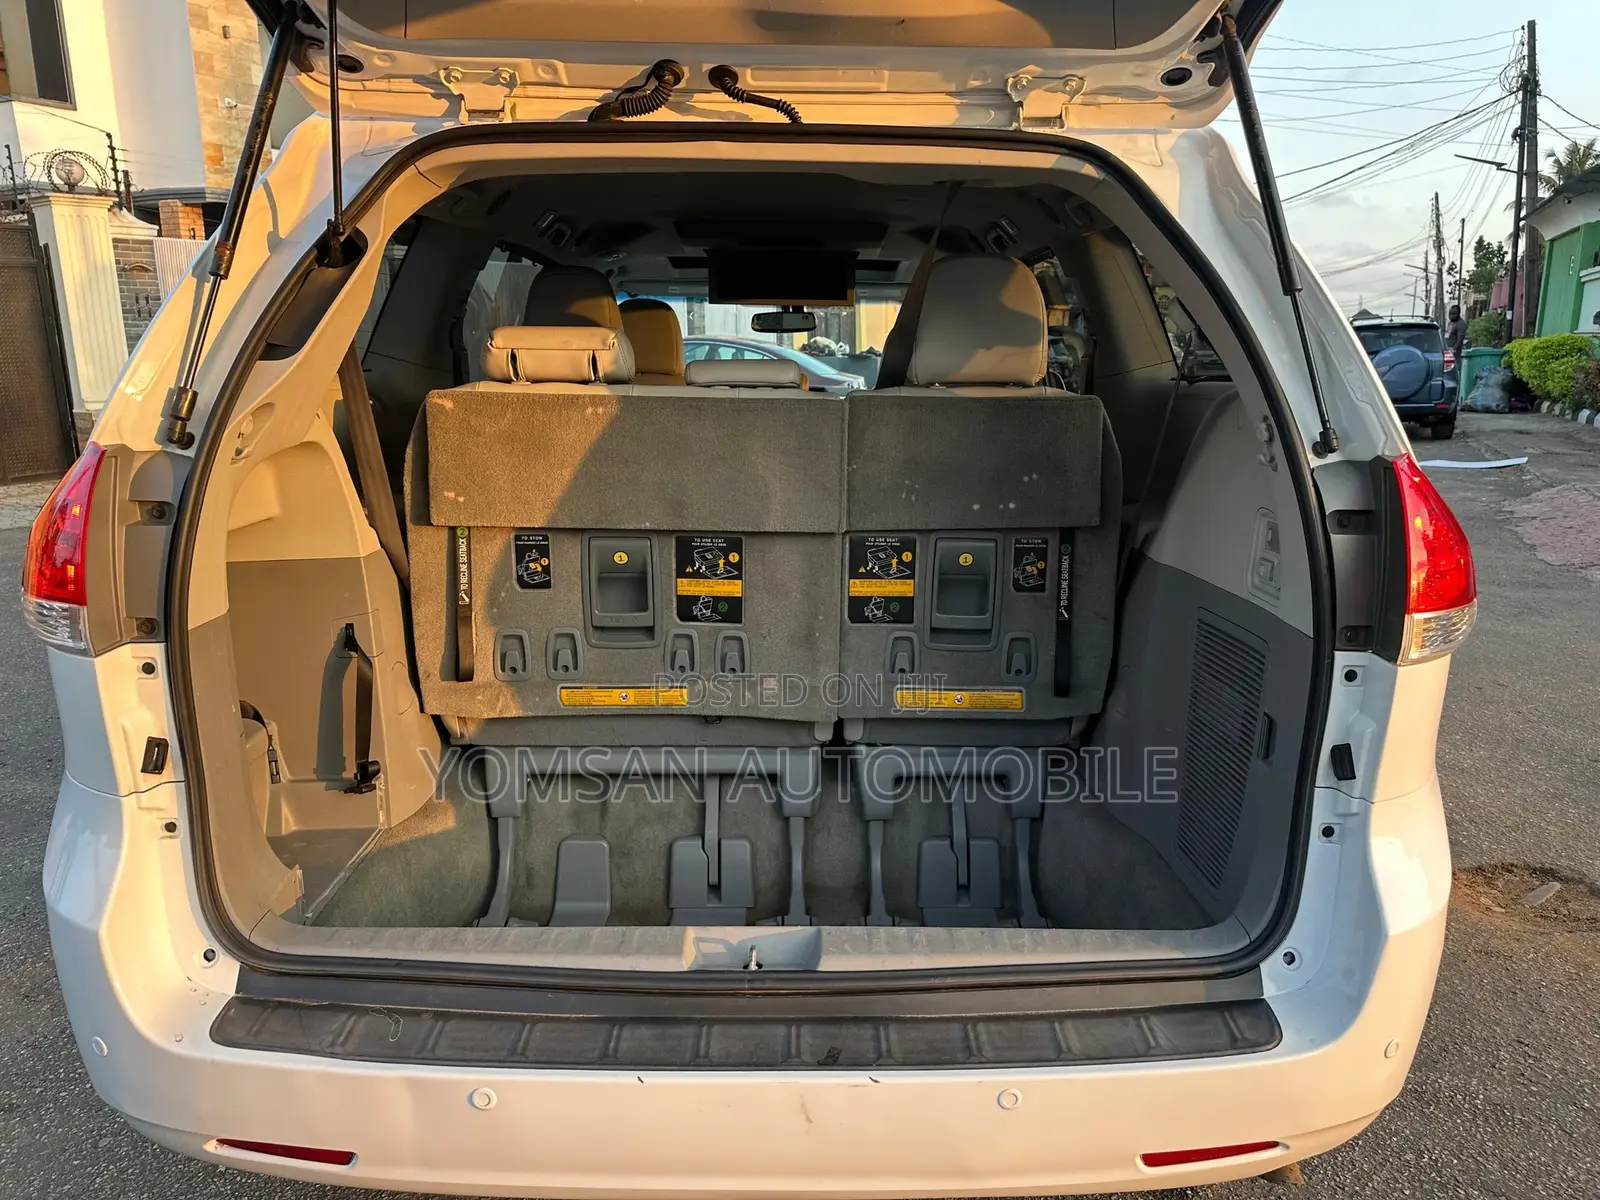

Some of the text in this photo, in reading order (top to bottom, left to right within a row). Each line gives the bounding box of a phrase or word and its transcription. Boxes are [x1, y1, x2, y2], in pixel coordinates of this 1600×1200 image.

[459, 538, 468, 563] SEATBACK
[460, 564, 468, 583] RECLINE
[1061, 555, 1069, 579] SEATBACK
